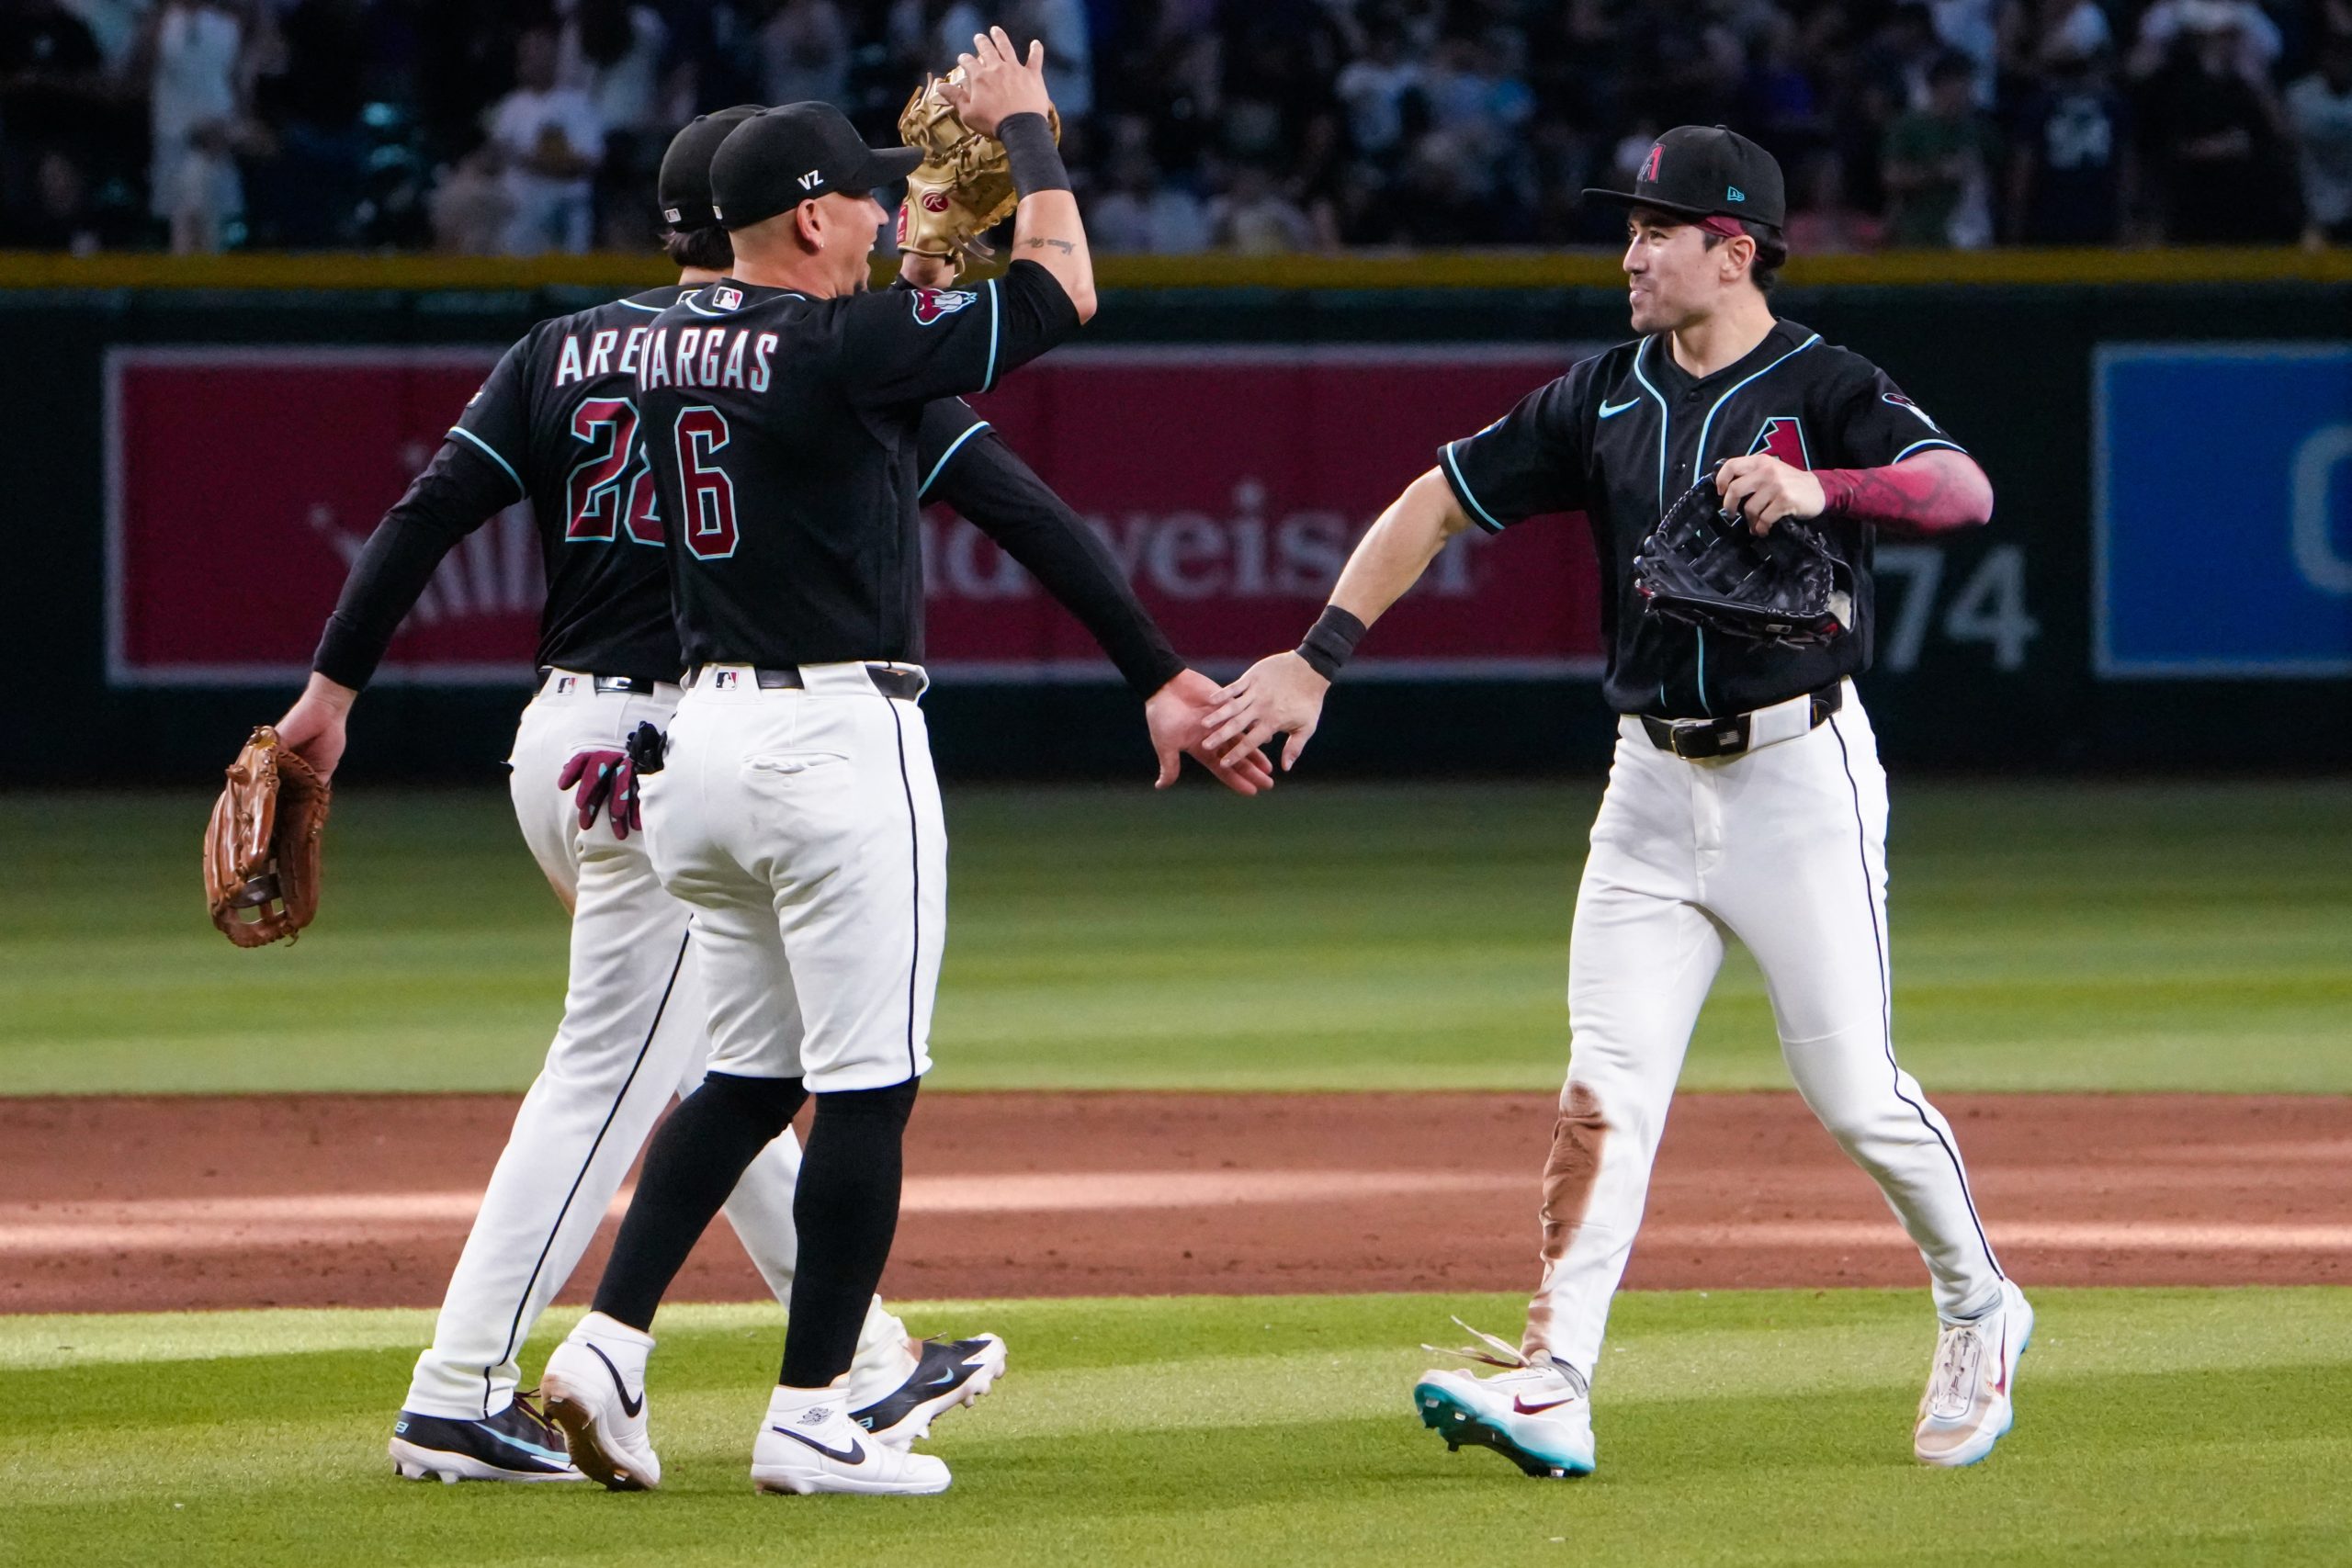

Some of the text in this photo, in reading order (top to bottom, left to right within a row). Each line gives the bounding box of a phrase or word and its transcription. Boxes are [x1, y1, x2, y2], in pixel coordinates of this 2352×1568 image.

[797, 169, 824, 191] VZ
[640, 327, 778, 393] VARGAS
[673, 405, 740, 560] 6
